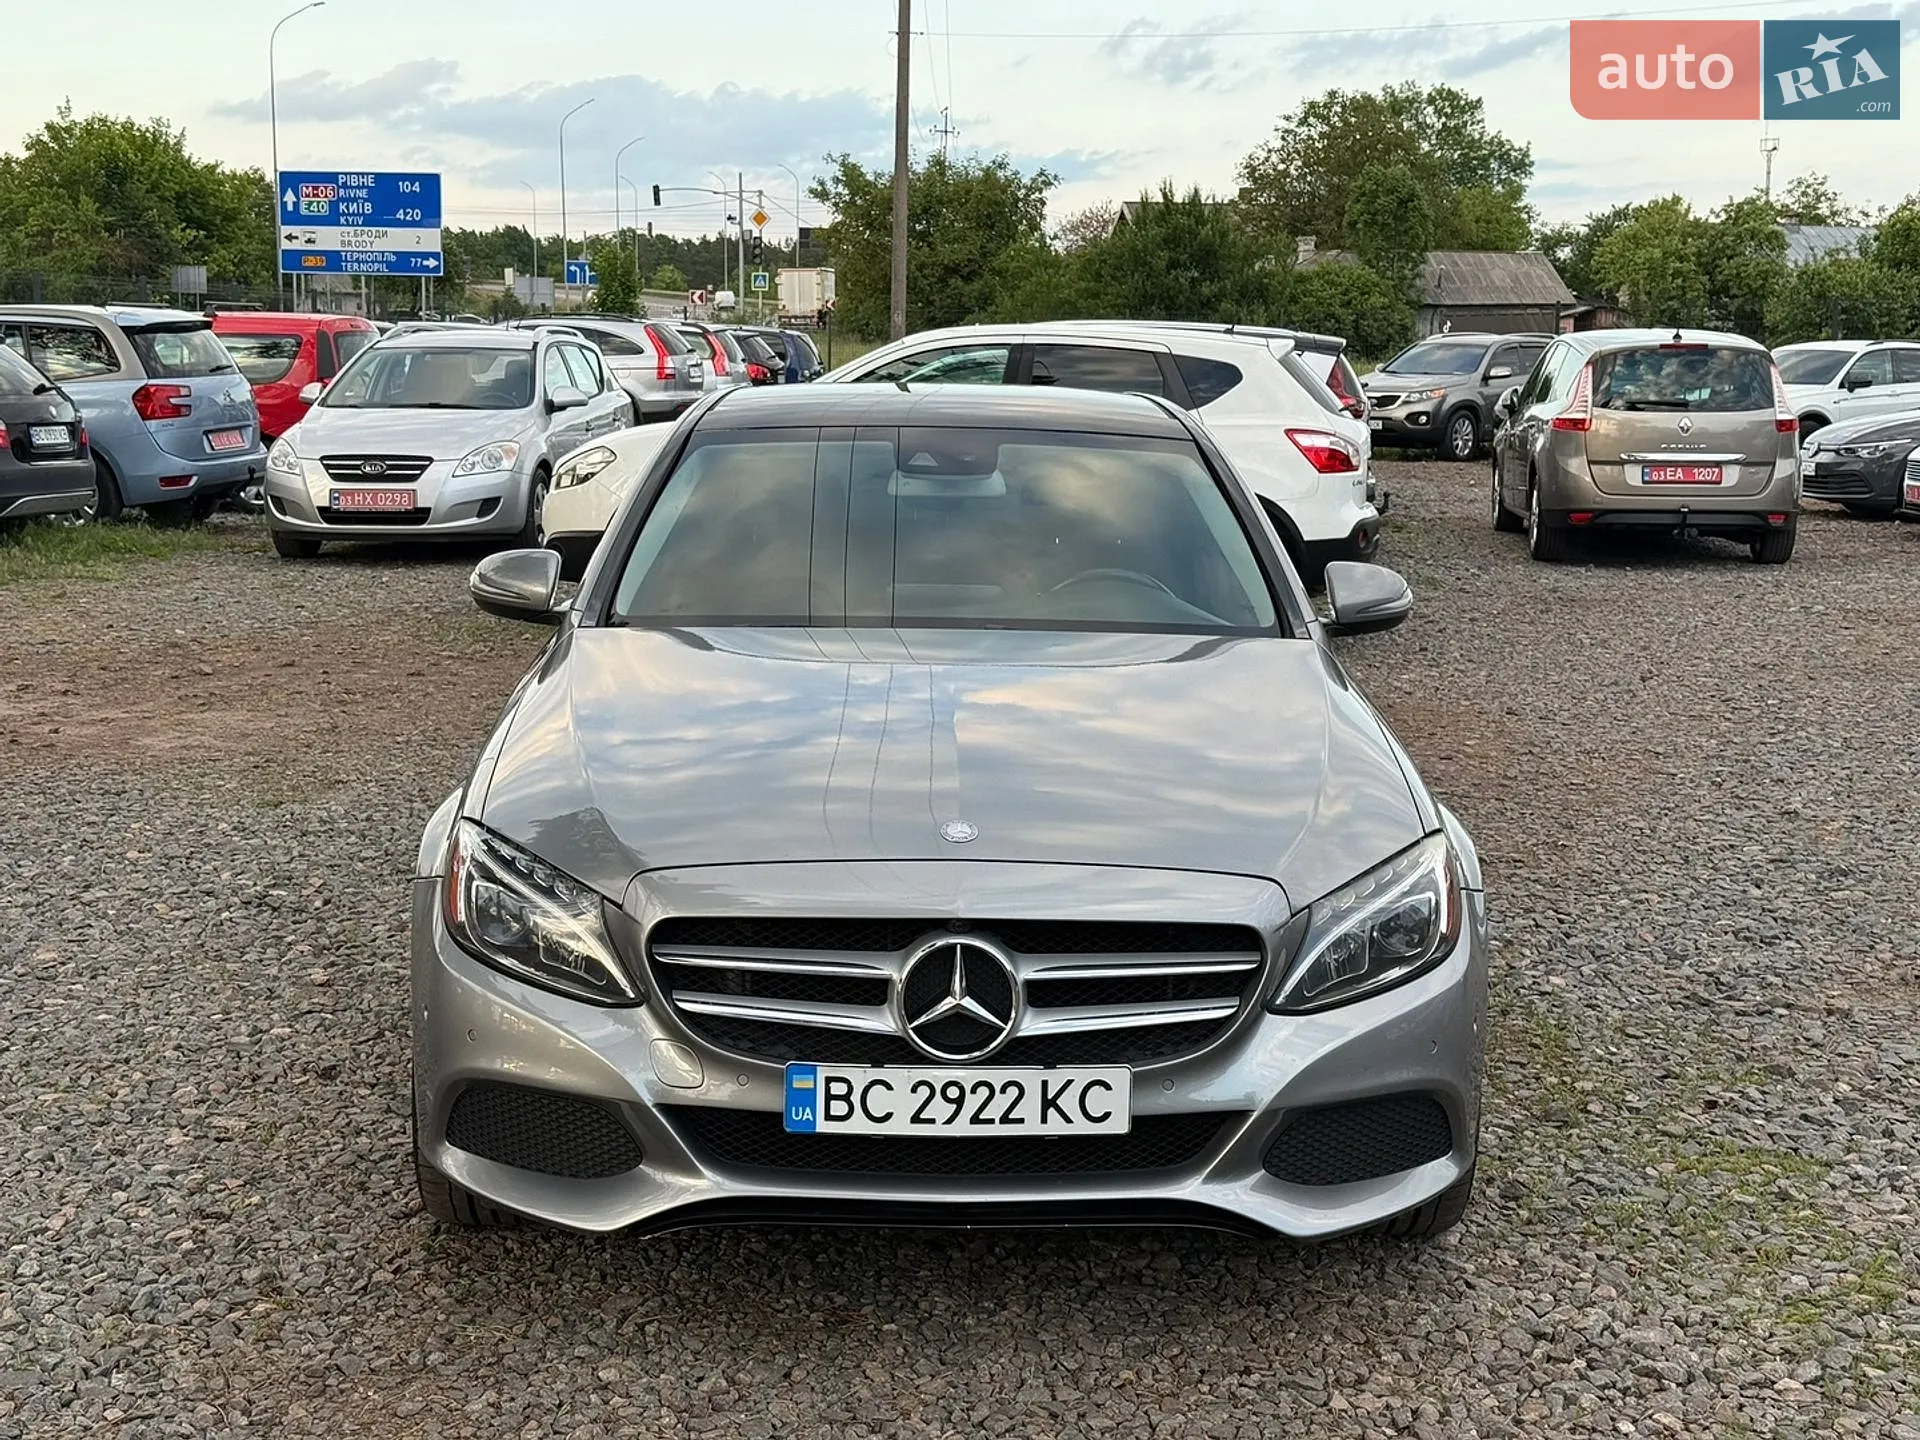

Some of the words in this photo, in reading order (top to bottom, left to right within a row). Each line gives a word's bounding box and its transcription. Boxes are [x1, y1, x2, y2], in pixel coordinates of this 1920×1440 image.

[338, 174, 376, 187] РІВНЕ
[398, 181, 420, 193] 104
[339, 188, 369, 198] RIVNE
[302, 201, 327, 213] E40
[339, 199, 373, 214] КИЇВ
[396, 208, 421, 221] 420
[340, 215, 364, 225] KYIV
[340, 240, 375, 249] BRODY
[415, 235, 421, 244] 2
[340, 262, 389, 272] TERNOPIL
[410, 257, 421, 267] 77
[365, 464, 382, 472] KIA
[1666, 468, 1684, 480] EA
[1692, 468, 1719, 480] 1207
[354, 493, 373, 505] HX
[377, 493, 409, 505] 0298
[792, 1106, 813, 1121] UA
[824, 1076, 894, 1124] BC
[910, 1079, 1026, 1126] 2922
[1040, 1078, 1113, 1125] KC
